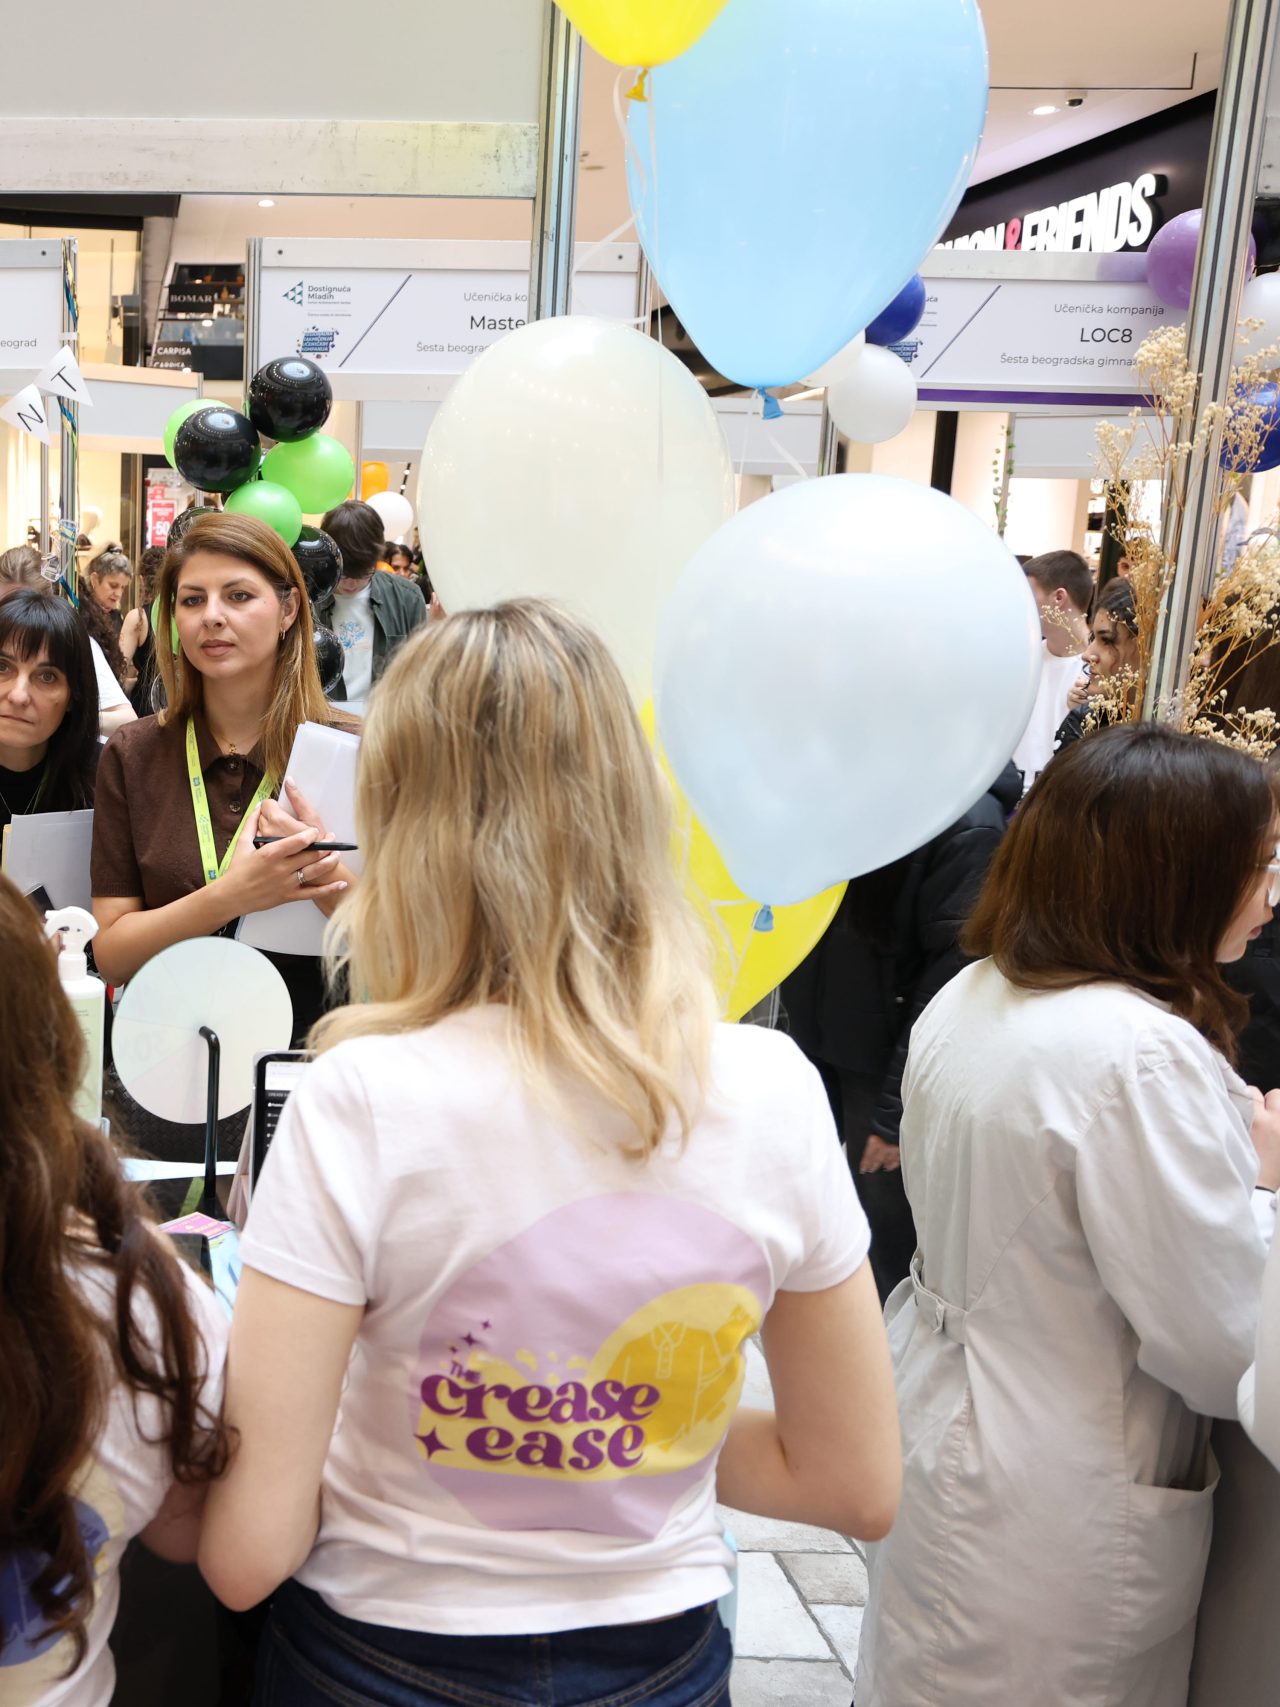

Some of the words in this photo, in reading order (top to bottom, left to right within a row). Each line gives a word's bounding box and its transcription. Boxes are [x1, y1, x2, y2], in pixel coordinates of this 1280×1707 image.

[307, 285, 351, 293] Dostignuća
[463, 292, 512, 302] Učenička
[1054, 303, 1104, 314] Učenička
[1107, 304, 1165, 317] kompanija
[469, 315, 526, 330] Maste
[1080, 327, 1133, 343] LOC8
[157, 346, 192, 356] CARPISA
[416, 341, 445, 352] Šesta
[999, 352, 1029, 364] Šesta
[1031, 355, 1095, 367] beogradska
[465, 1424, 645, 1471] ease
